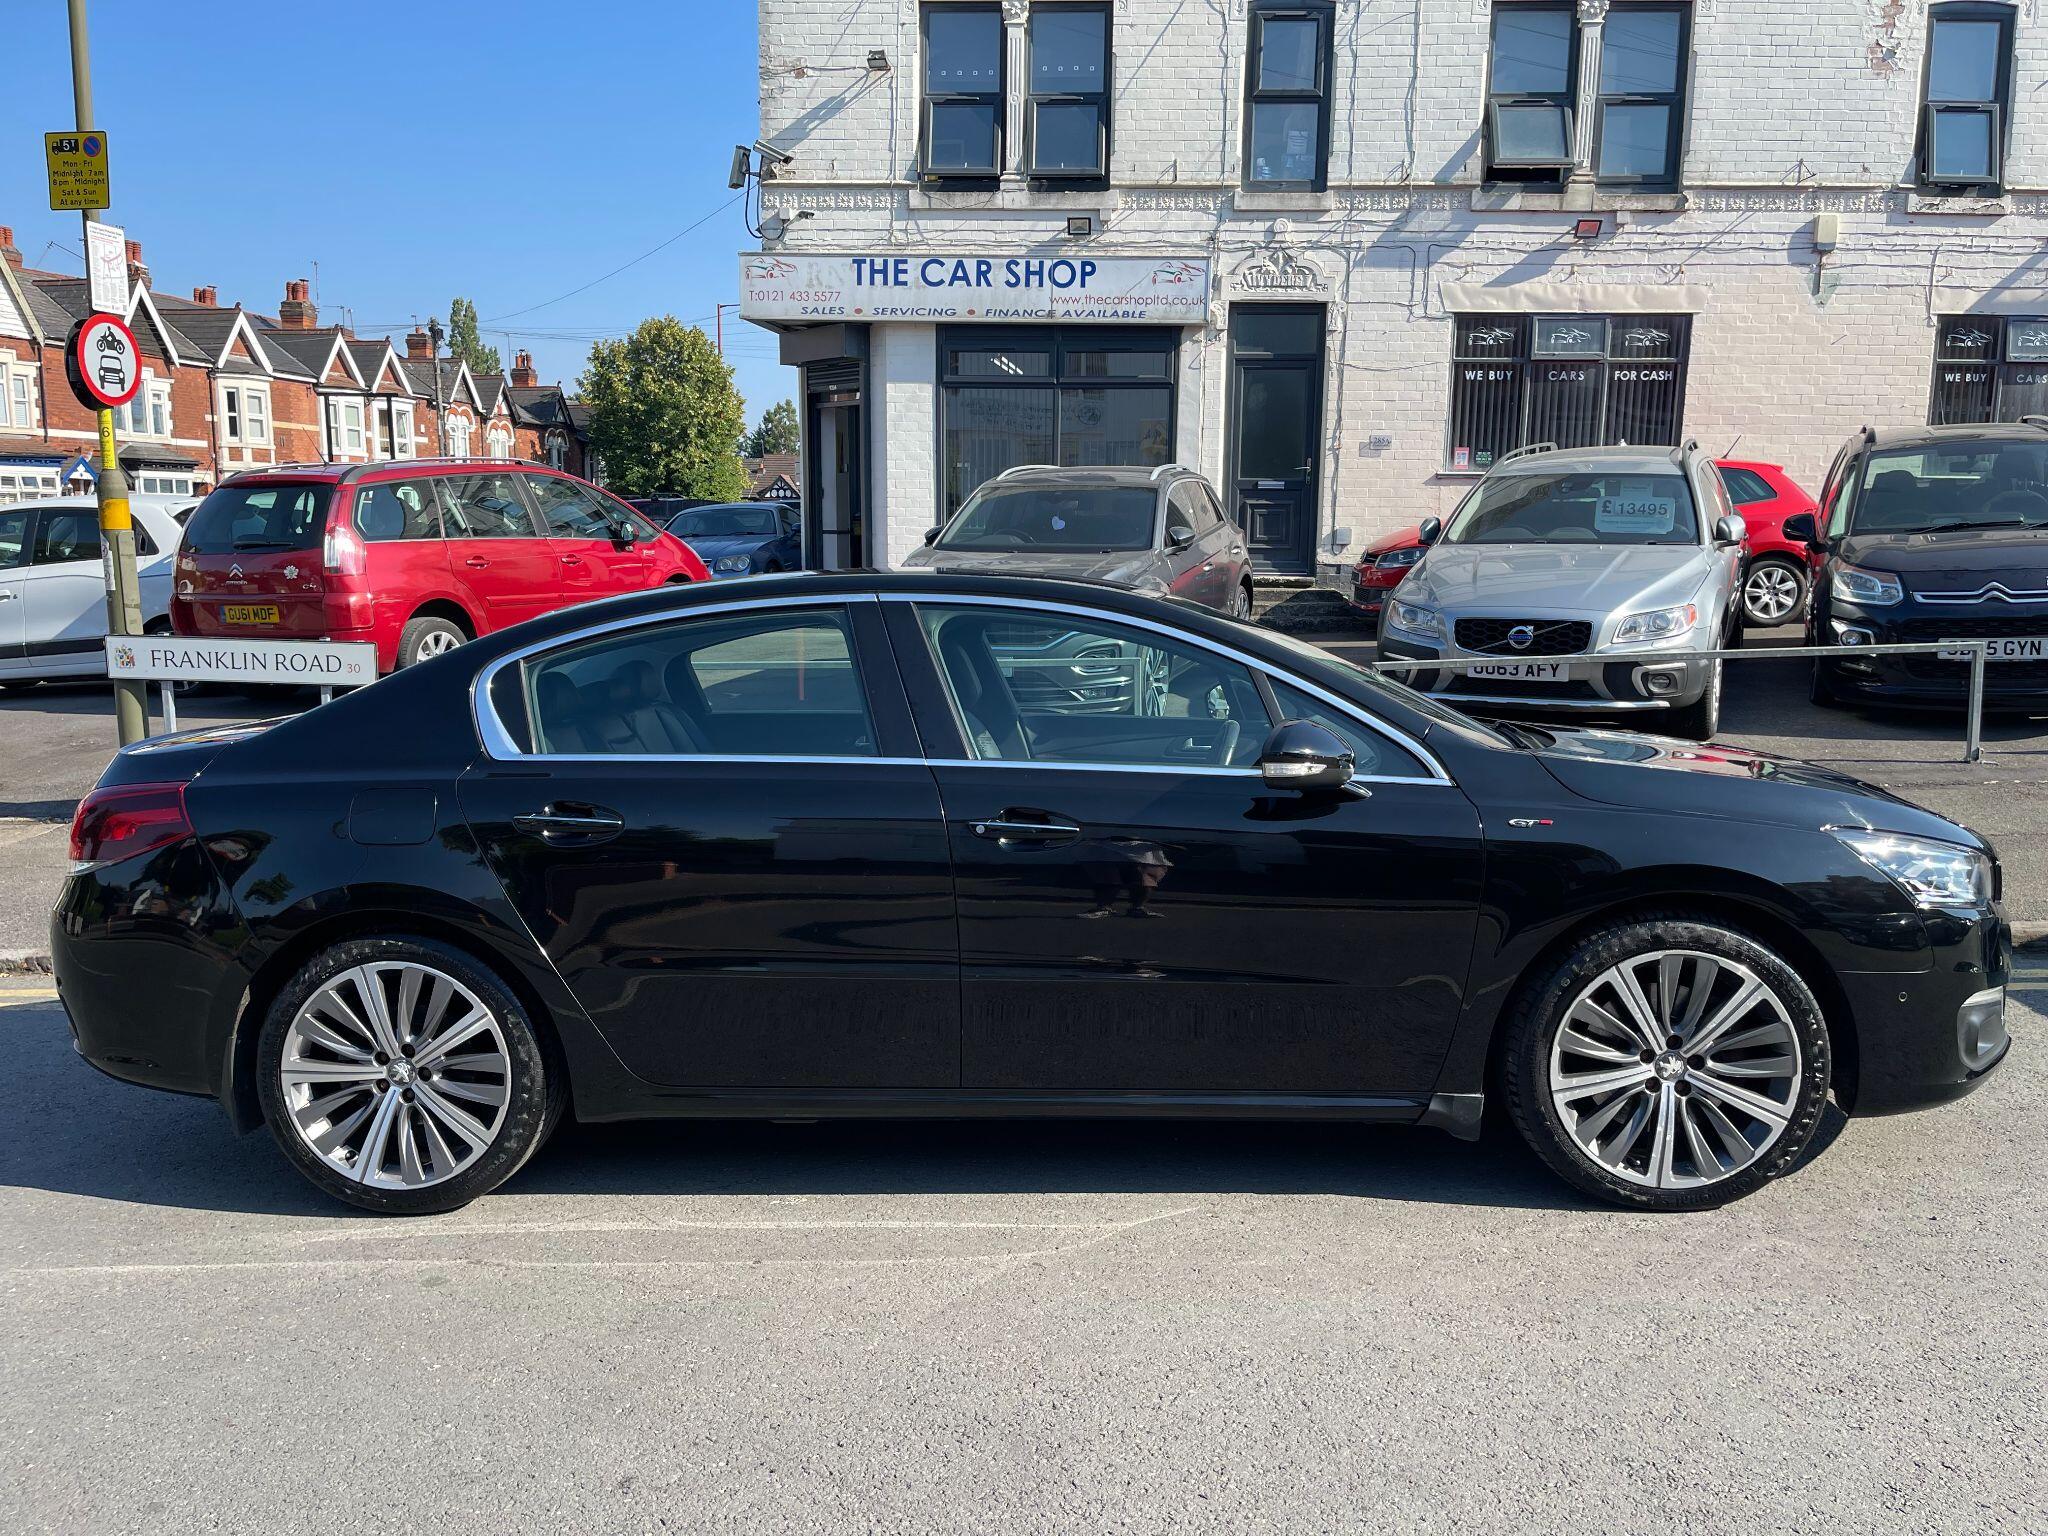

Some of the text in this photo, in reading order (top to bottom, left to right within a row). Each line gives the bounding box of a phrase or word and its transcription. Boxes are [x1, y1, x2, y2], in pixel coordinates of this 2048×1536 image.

[53, 169, 83, 178] Midnight
[75, 178, 105, 186] Midnight
[83, 188, 97, 196] Sun
[851, 258, 1097, 289] THE CAR SHOP
[749, 290, 841, 303] T:0121 433 5577
[1050, 294, 1206, 307] www.thecarshopltd.co.uk
[801, 306, 845, 315] SALES
[872, 307, 958, 316] SERVICING
[985, 308, 1147, 319] FINANCE AVAILABLE
[1464, 370, 1673, 381] WE BUY CARS FOR CASH
[1945, 373, 2048, 383] WE BUY CARS
[1618, 502, 1668, 516] 13495
[228, 607, 276, 620] GU61 MDF
[2003, 640, 2042, 656] GYN
[150, 649, 361, 674] FRANKLIN ROAD 30
[1525, 663, 1560, 678] AFY
